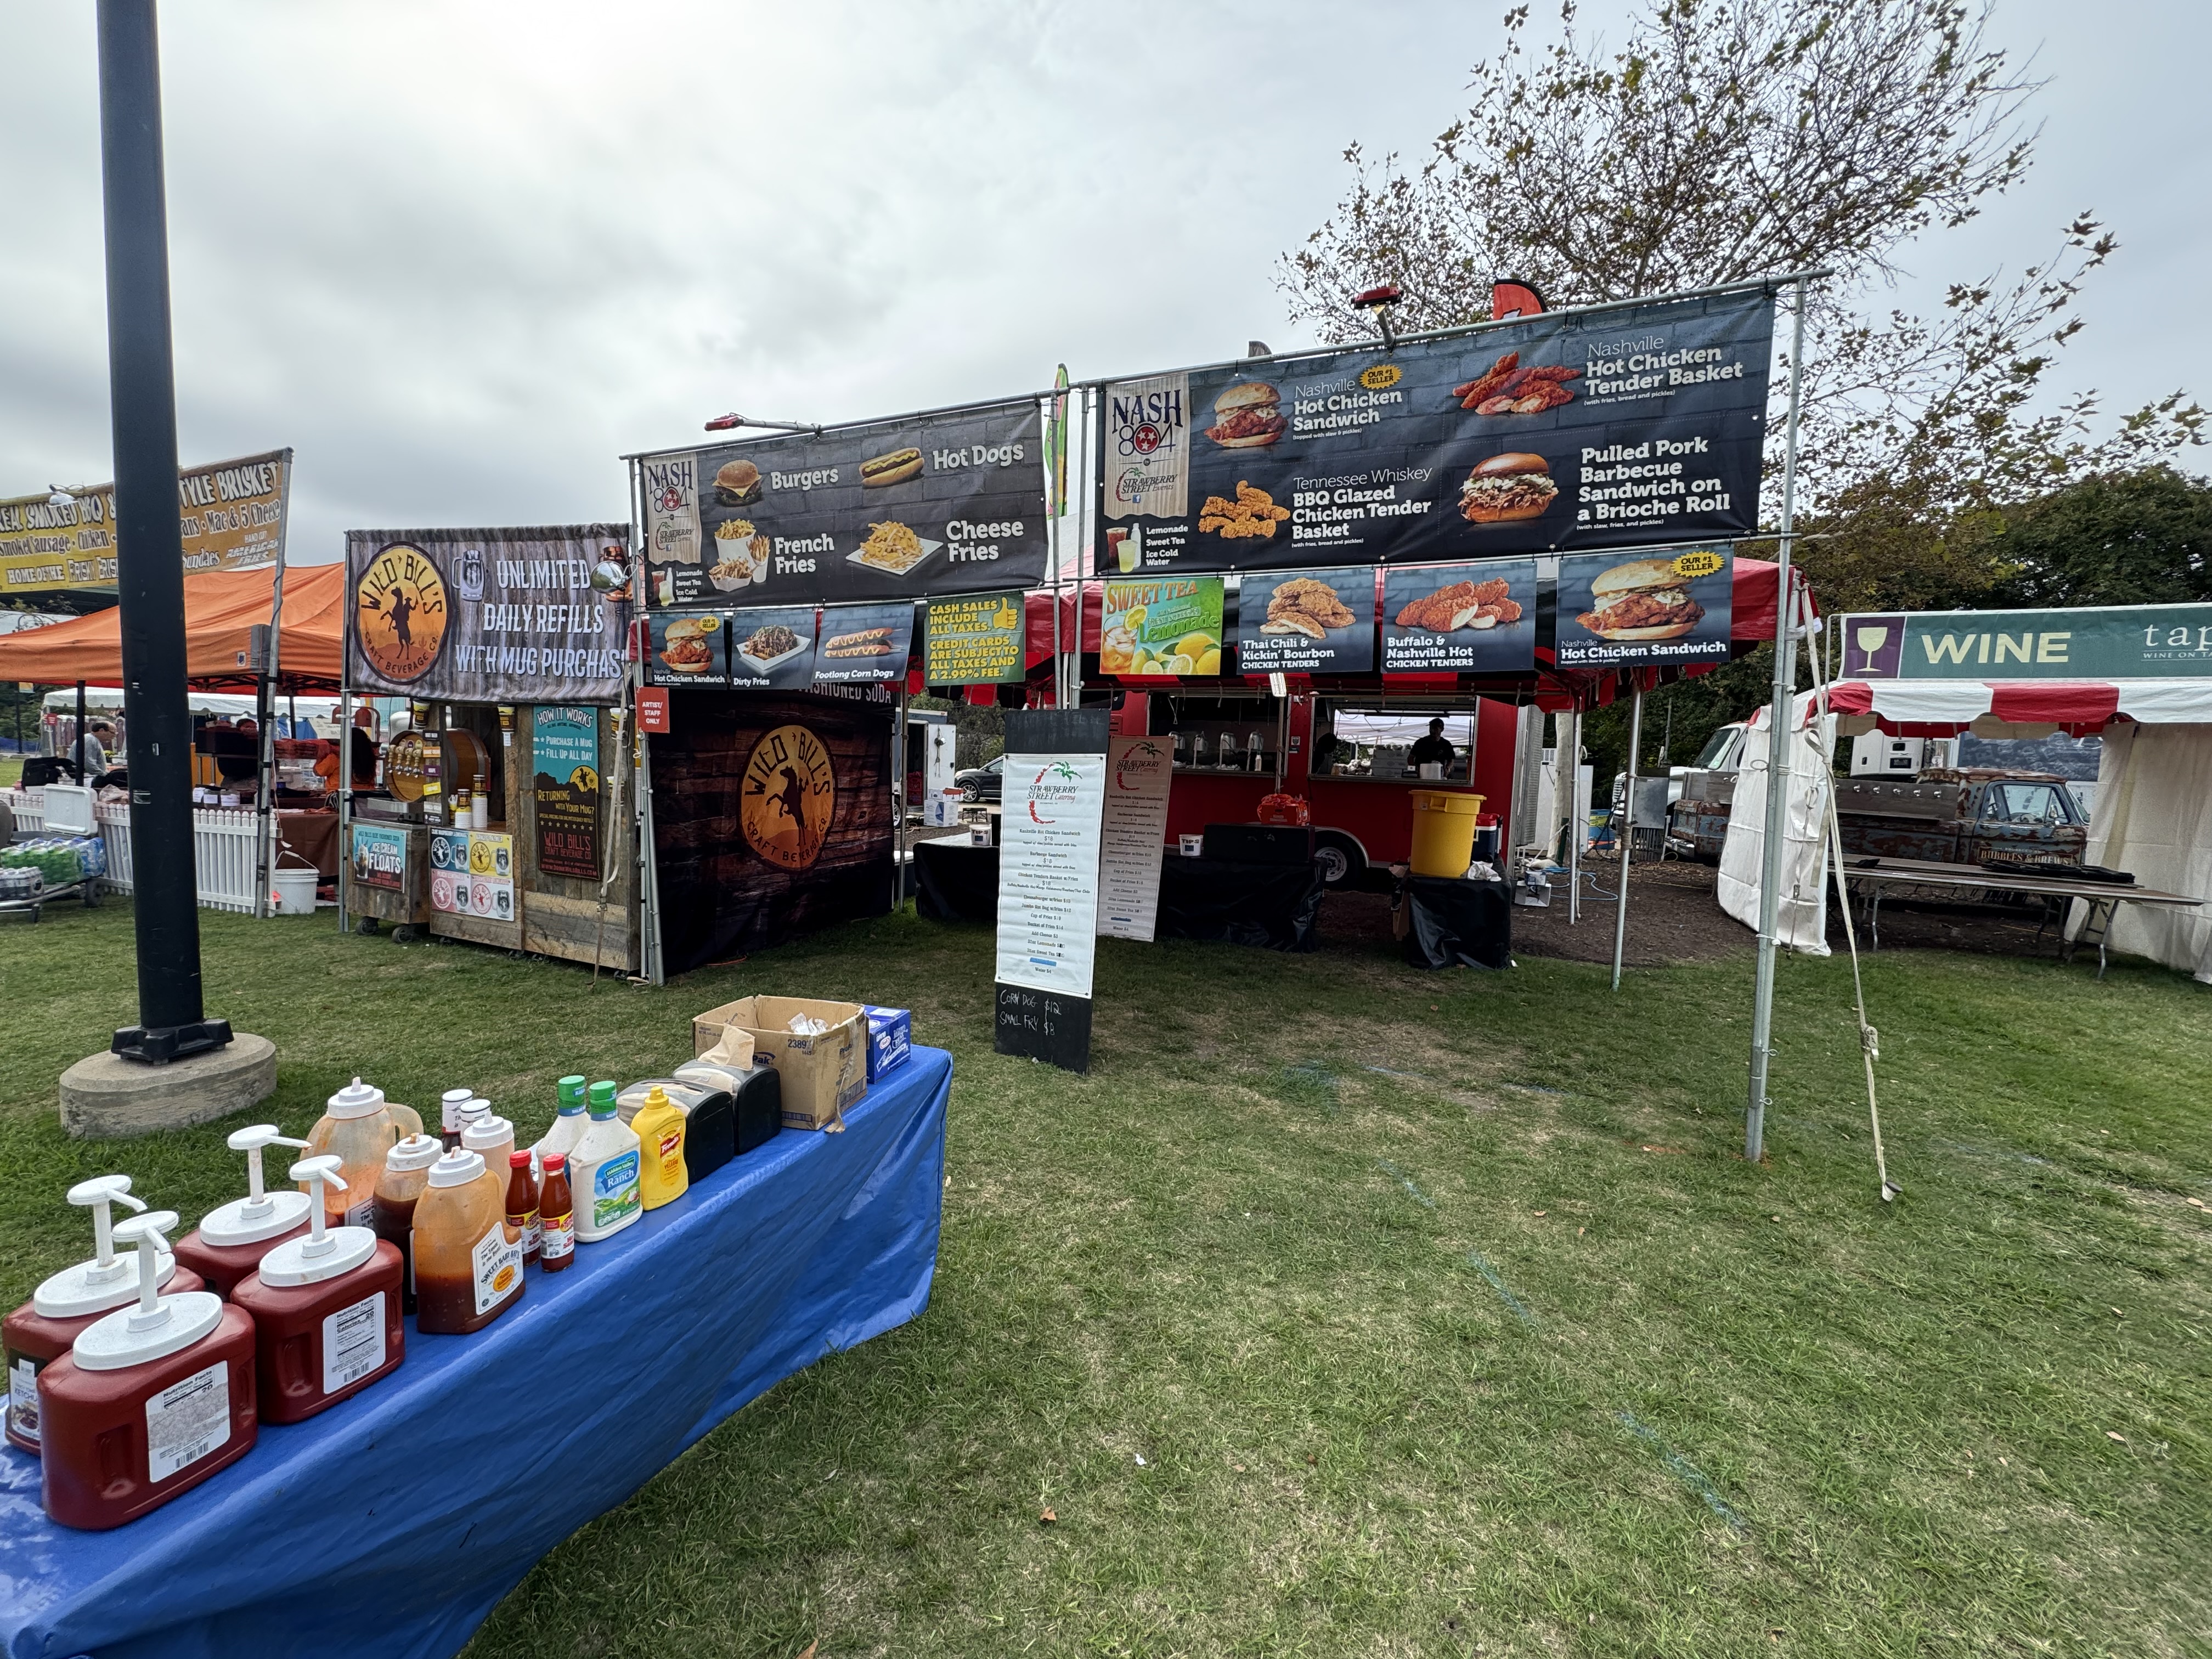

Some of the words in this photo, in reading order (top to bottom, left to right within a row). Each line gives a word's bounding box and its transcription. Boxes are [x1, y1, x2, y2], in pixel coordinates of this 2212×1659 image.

[1588, 335, 1664, 358] Nashville
[1586, 360, 1624, 378] Hot
[1628, 347, 1722, 372] Chicken
[1367, 370, 1383, 379] OUR
[1367, 375, 1394, 385] SELLER
[1585, 373, 1669, 396] Tender
[1668, 362, 1743, 386] Basket
[1294, 377, 1356, 399] Nashville
[1112, 389, 1183, 434] NASH
[1294, 398, 1324, 415] Hot
[1327, 390, 1402, 413] Chicken
[1293, 409, 1380, 432] Sandwich
[933, 449, 968, 470] Hot
[972, 443, 1024, 467] Dogs
[1581, 442, 1650, 464] Pulled
[1656, 437, 1708, 456] Pork
[647, 460, 693, 495] NASH
[771, 468, 839, 491] Burgers
[1122, 473, 1178, 488] STRAWBERRY
[1293, 474, 1368, 490] Tennessee
[1371, 466, 1433, 484] Whiskey
[1580, 461, 1683, 483] Barbecue
[216, 462, 278, 501] BRISKET
[1121, 484, 1152, 495] STREET
[1578, 479, 1685, 503] Sandwich
[1691, 478, 1722, 492] on
[1293, 490, 1330, 507] BBQ
[1333, 485, 1396, 505] Glazed
[1293, 506, 1364, 523] Chicken
[1367, 500, 1432, 518] Tender
[1577, 508, 1590, 521] a
[1595, 500, 1679, 520] Brioche
[1686, 493, 1730, 512] Roll
[206, 510, 227, 532] Mac
[230, 507, 238, 528] &
[241, 506, 248, 527] 5
[946, 521, 1024, 541] Cheese
[1146, 524, 1188, 535] Lemonade
[1292, 523, 1350, 539] Basket
[774, 533, 834, 555] French
[1146, 538, 1170, 546] Sweet
[947, 541, 999, 563] Fries
[1159, 549, 1179, 557] Cold
[1680, 556, 1700, 565] OUR
[1702, 555, 1712, 563] #1
[775, 556, 816, 574] Fries
[1146, 558, 1170, 567] Water
[1680, 563, 1714, 572] SELLER
[8, 568, 36, 583] HOME
[496, 559, 591, 590] UNLIMITED
[361, 557, 398, 611] WILD
[1107, 583, 1163, 615] SWEET
[1164, 580, 1199, 601] TEA
[929, 603, 960, 614] CASH
[962, 600, 997, 612] SALES
[483, 603, 533, 634] DAILY
[537, 604, 604, 634] REFILLS
[929, 613, 978, 625] INCLUDE
[1138, 611, 1220, 643] Lemonade
[929, 625, 950, 635] ALL
[952, 622, 991, 633] TAXES.
[930, 639, 969, 650] CREDIT
[971, 636, 1010, 647] CARDS
[1243, 639, 1269, 650] Thai
[1271, 637, 1298, 649] Chili
[1300, 637, 1308, 647] &
[1387, 637, 1434, 648] Buffalo
[1436, 636, 1445, 646] &
[1561, 648, 1586, 659] Hot
[1588, 646, 1647, 658] Chicken
[1651, 641, 1726, 655] Sandwich
[1921, 631, 2071, 664] WINE
[455, 645, 496, 673] WITH
[500, 647, 538, 676] MUG
[929, 650, 952, 660] ARE
[954, 647, 1002, 658] SUBJECT
[1003, 646, 1019, 655] TO
[1242, 648, 1282, 661] Kickin'
[1284, 648, 1335, 660] Bourbon
[1386, 647, 1447, 659] Nashville
[1449, 647, 1473, 657] Hot
[929, 661, 950, 670] ALL
[952, 658, 988, 669] TAXES
[990, 656, 1016, 667] AND
[1242, 660, 1279, 670] CHICKEN
[1281, 659, 1319, 669] TENDERS
[1386, 659, 1428, 668] CHICKEN
[1430, 658, 1474, 667] TENDERS
[693, 675, 725, 684] Sandwich
[733, 678, 752, 687] Dirty
[752, 678, 770, 686] Fries
[815, 670, 850, 680] Footlong
[851, 669, 871, 678] Corn
[872, 669, 894, 679] Dogs
[929, 670, 938, 680] A
[940, 669, 979, 679] 2.99%
[981, 667, 1004, 677] FEE.
[537, 708, 554, 725] HOW
[556, 707, 565, 720] IT
[566, 707, 593, 728] WORKS
[546, 736, 573, 746] PURCHASE
[580, 737, 592, 748] MUG
[546, 748, 558, 758] FILL
[559, 749, 568, 759] UP
[569, 749, 580, 760] ALL
[581, 751, 592, 761] DAY
[744, 734, 789, 797] WILD
[538, 789, 570, 801] RETURNING
[1029, 785, 1079, 793] STRAWBERRY
[1054, 793, 1076, 804] Catering
[565, 803, 579, 814] YOUR
[580, 804, 595, 815] MUG?
[381, 843, 398, 855] CREAM
[544, 831, 563, 848] WILD
[567, 834, 591, 851] BILL'S
[368, 853, 401, 874] FLOATS
[1981, 850, 2024, 862] BUBBLES
[2025, 854, 2034, 862] &
[2034, 855, 2070, 865] BREWS
[1000, 989, 1019, 1005] CORN
[1022, 995, 1037, 1007] DOG
[1000, 1012, 1021, 1026] SMALL
[1024, 1015, 1039, 1031] FRY
[788, 1039, 806, 1049] 2389
[607, 1169, 635, 1188] Ranch
[481, 1261, 498, 1284] SWEET
[498, 1252, 510, 1264] BABY
[336, 1305, 360, 1318] Nutrition
[361, 1298, 374, 1307] Facts
[337, 1319, 360, 1333] Calories
[163, 1381, 194, 1398] Nutrition
[195, 1370, 212, 1381] Facts
[202, 1384, 213, 1393] 20
